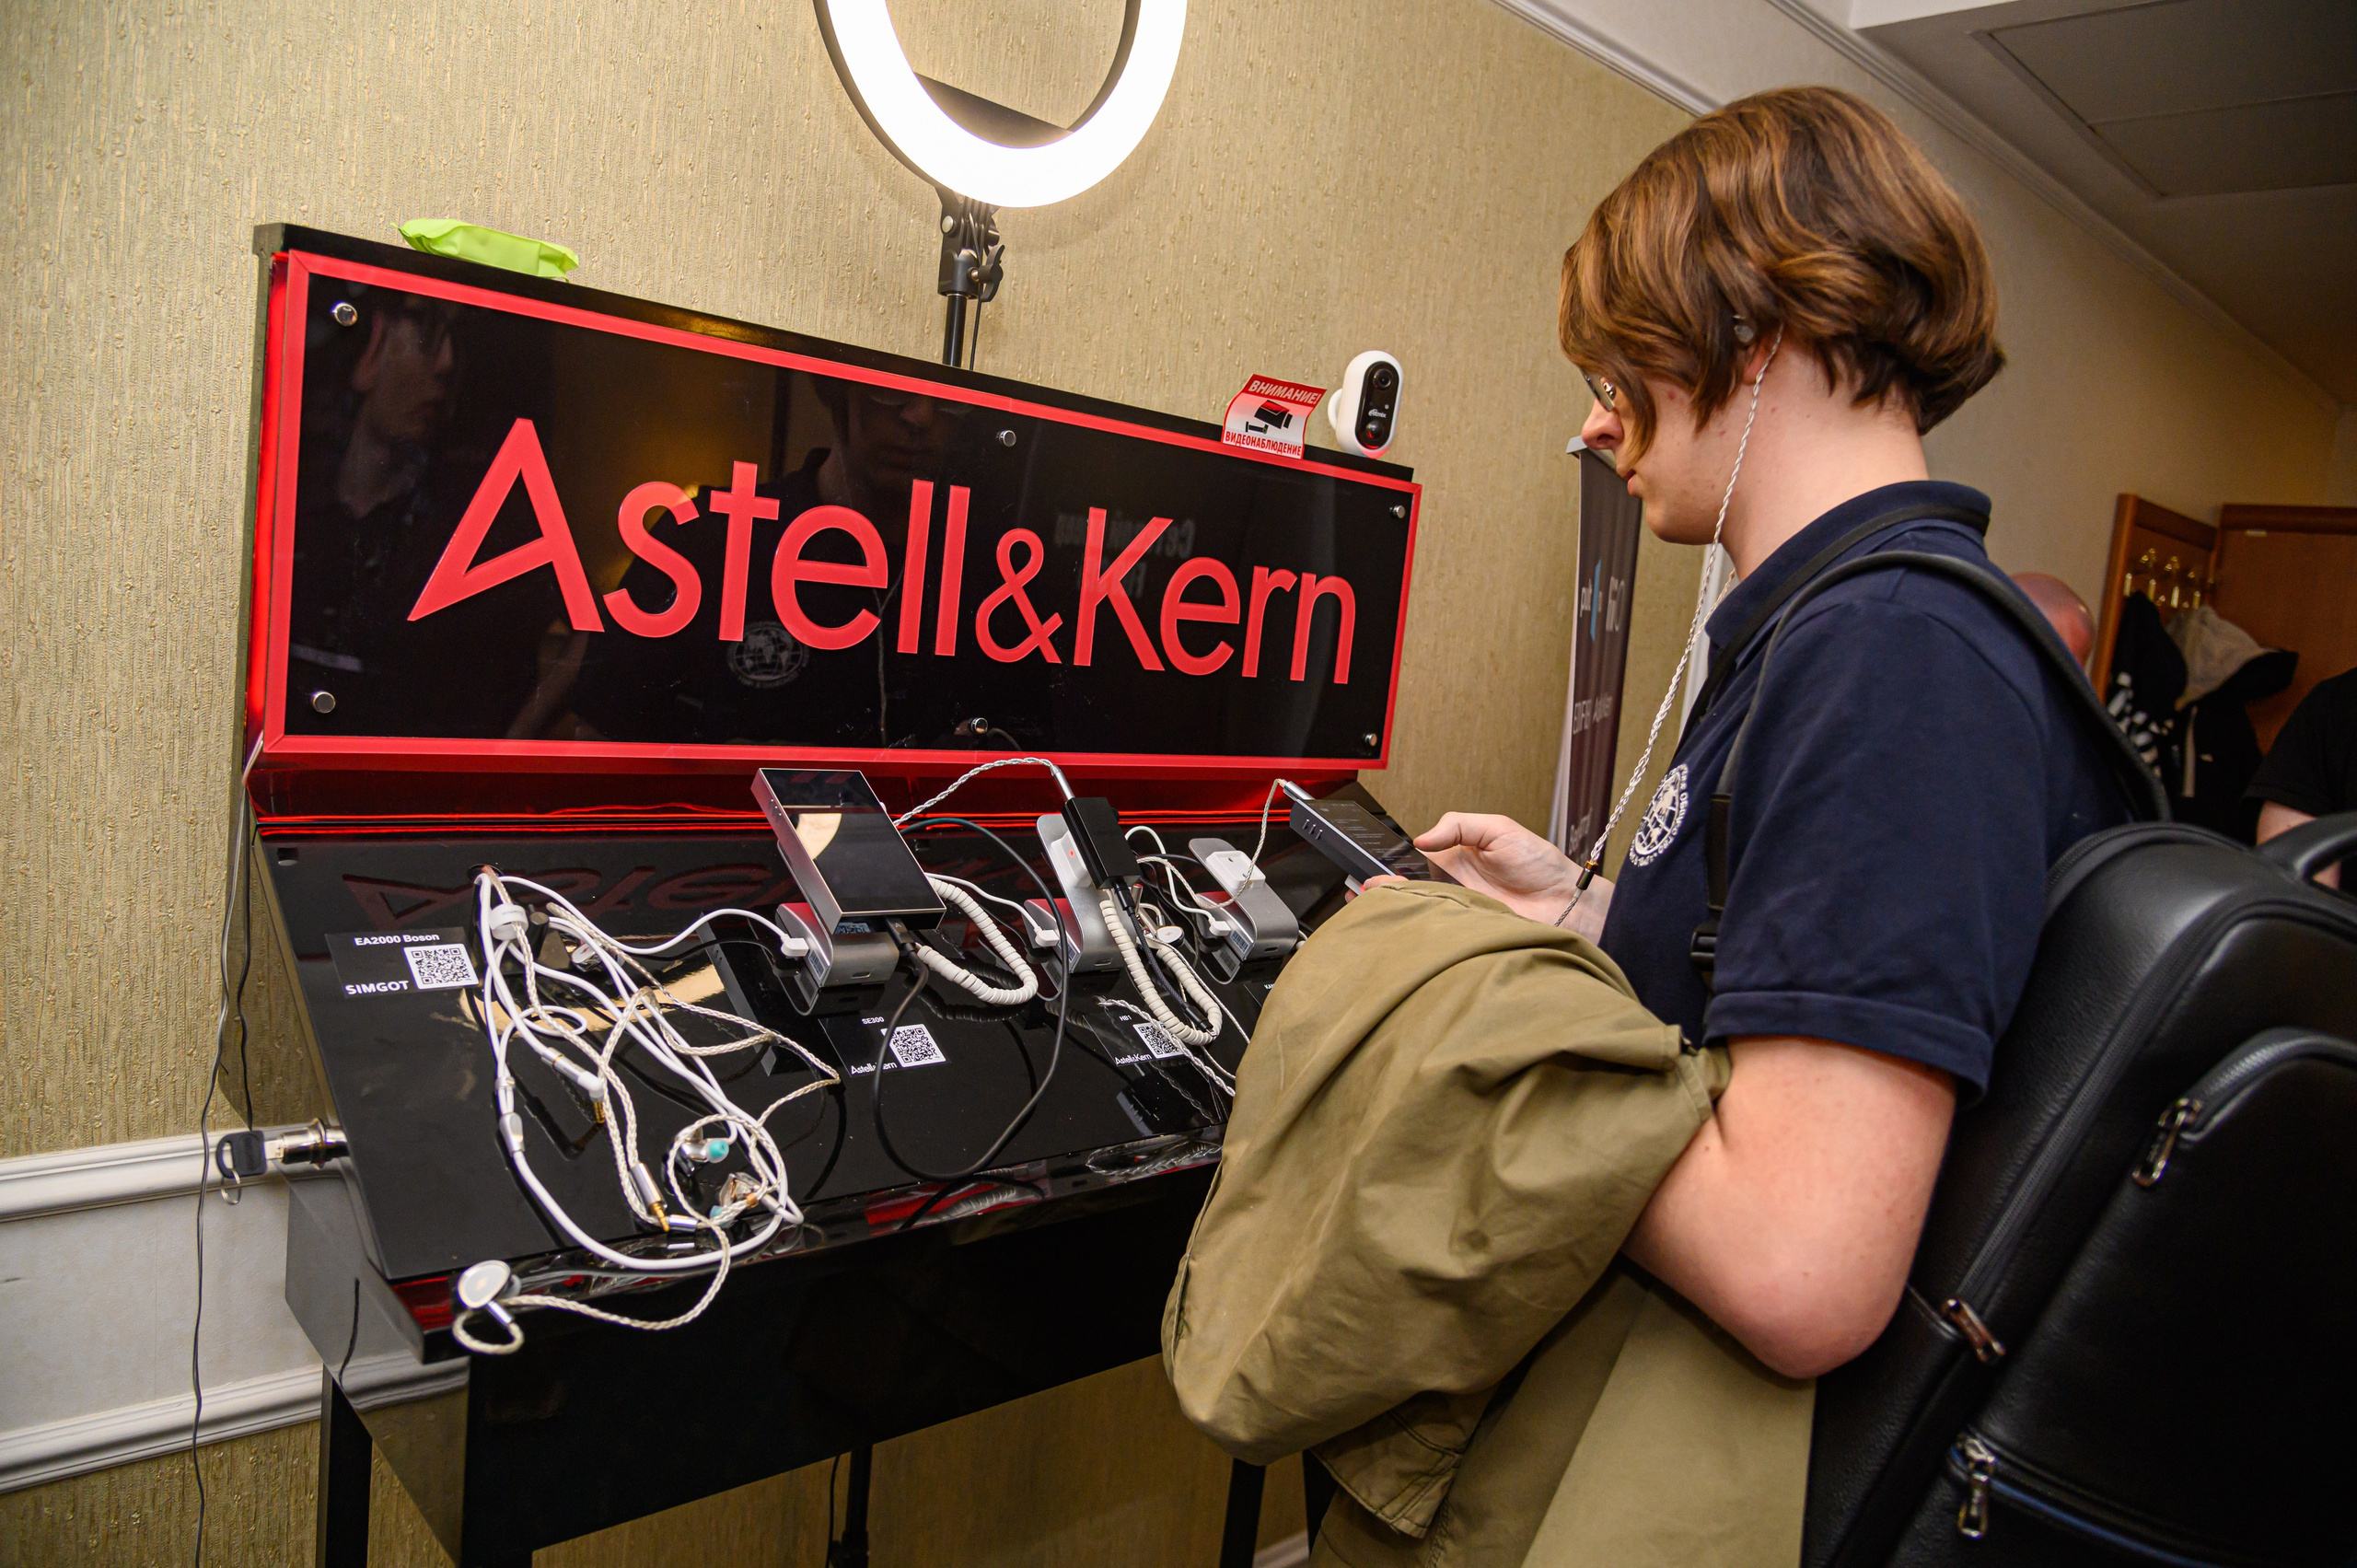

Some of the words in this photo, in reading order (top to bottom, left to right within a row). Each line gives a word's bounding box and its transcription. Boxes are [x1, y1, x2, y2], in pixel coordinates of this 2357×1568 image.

[1248, 379, 1321, 405] ВНИМАНИЕ!
[1225, 430, 1302, 457] ВИДЕОНАБЛЮДЕНИЕ
[407, 417, 1356, 685] Astell&Kern
[354, 934, 401, 947] EA2000
[402, 934, 440, 943] Boson
[344, 980, 410, 995] SIMGOT
[861, 1016, 885, 1025] SE300
